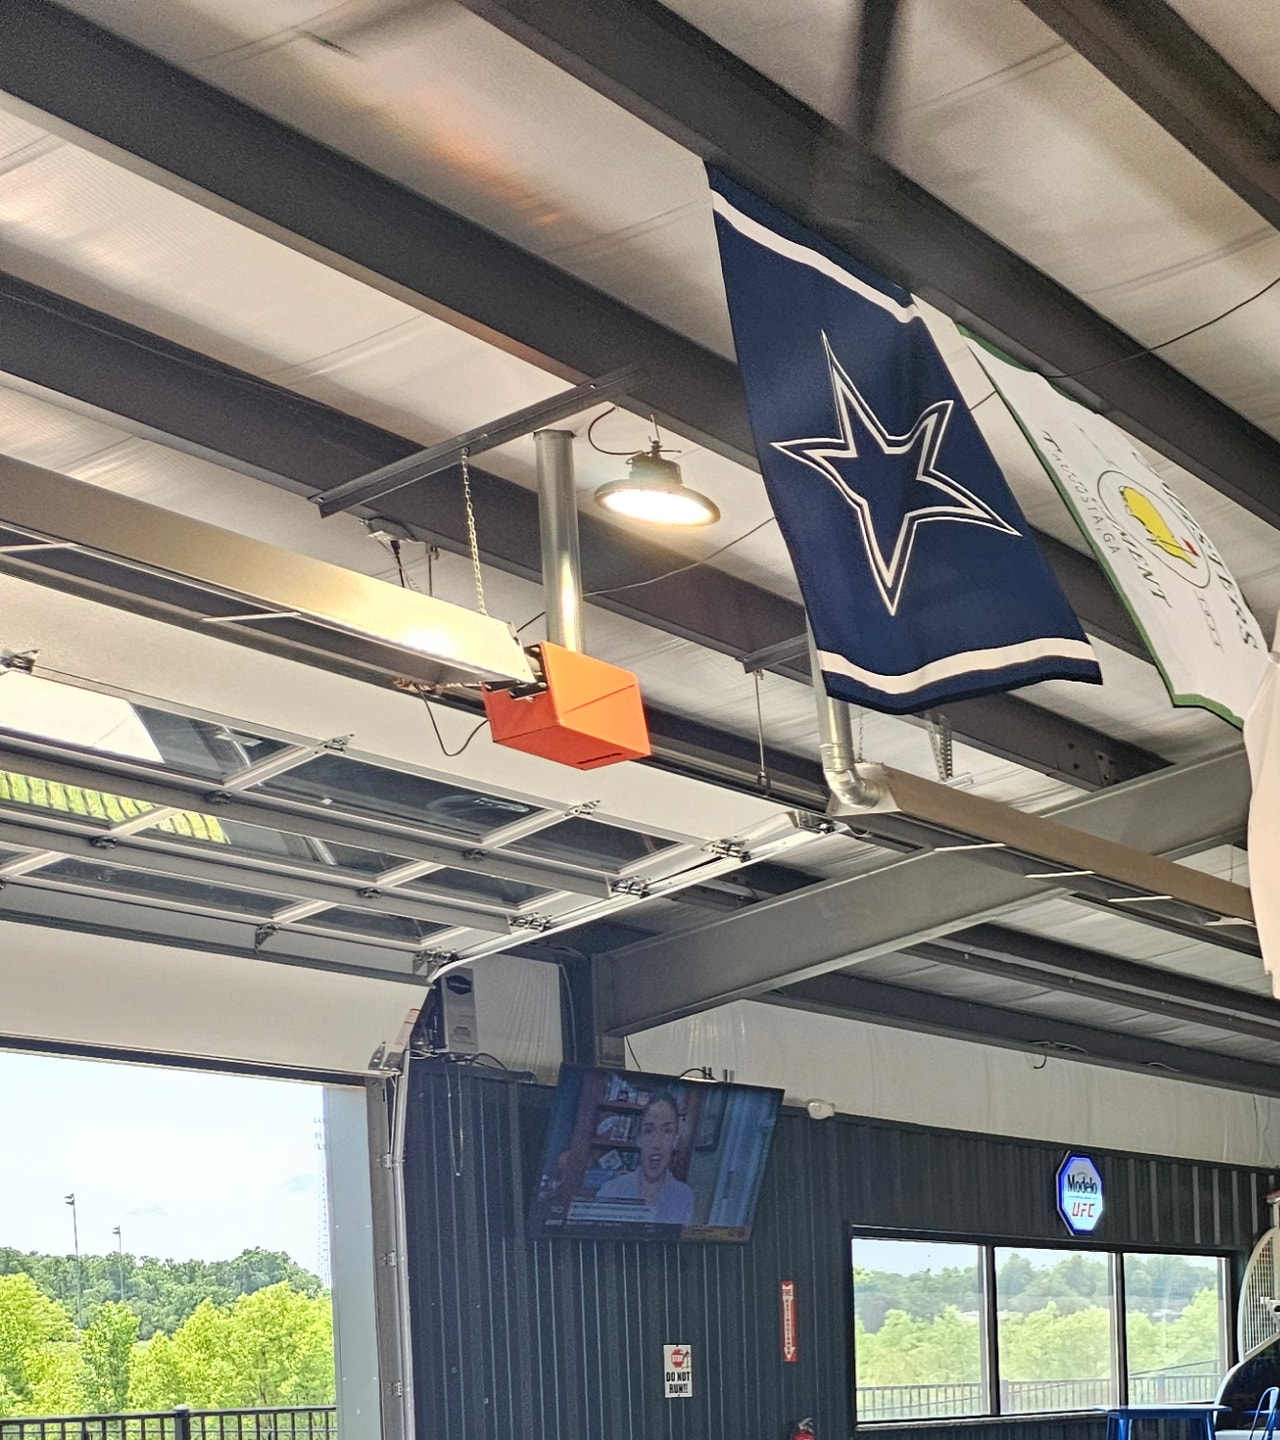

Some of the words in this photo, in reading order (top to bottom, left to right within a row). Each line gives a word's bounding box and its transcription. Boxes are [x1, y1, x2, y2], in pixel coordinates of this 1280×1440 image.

[1067, 1173, 1098, 1194] Modelo
[1072, 1201, 1095, 1218] UFC
[665, 1371, 676, 1382] DO
[677, 1371, 691, 1382] NOT
